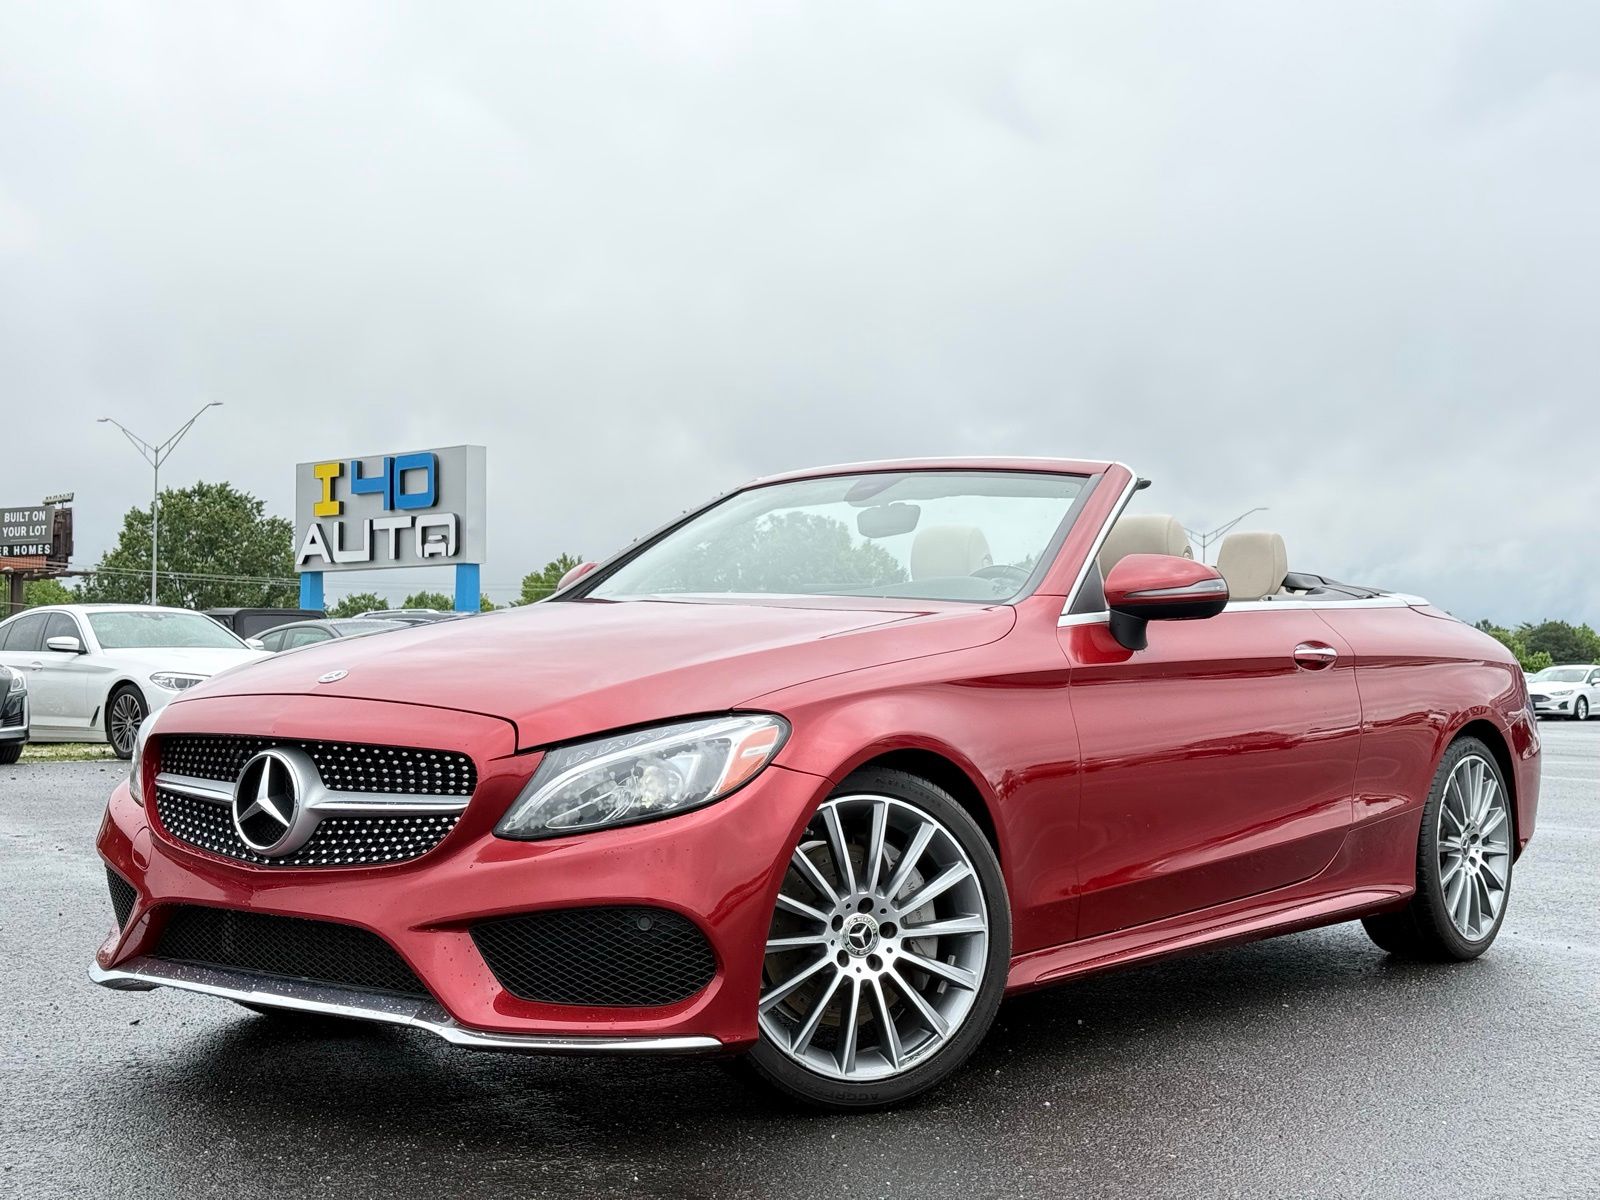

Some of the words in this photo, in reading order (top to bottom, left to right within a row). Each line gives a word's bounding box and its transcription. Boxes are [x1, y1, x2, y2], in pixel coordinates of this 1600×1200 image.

[4, 512, 30, 523] BUILT
[32, 511, 46, 521] ON
[2, 526, 27, 537] YOUR
[29, 525, 47, 536] LOT
[296, 513, 459, 565] AUTO
[13, 544, 51, 556] HOMES
